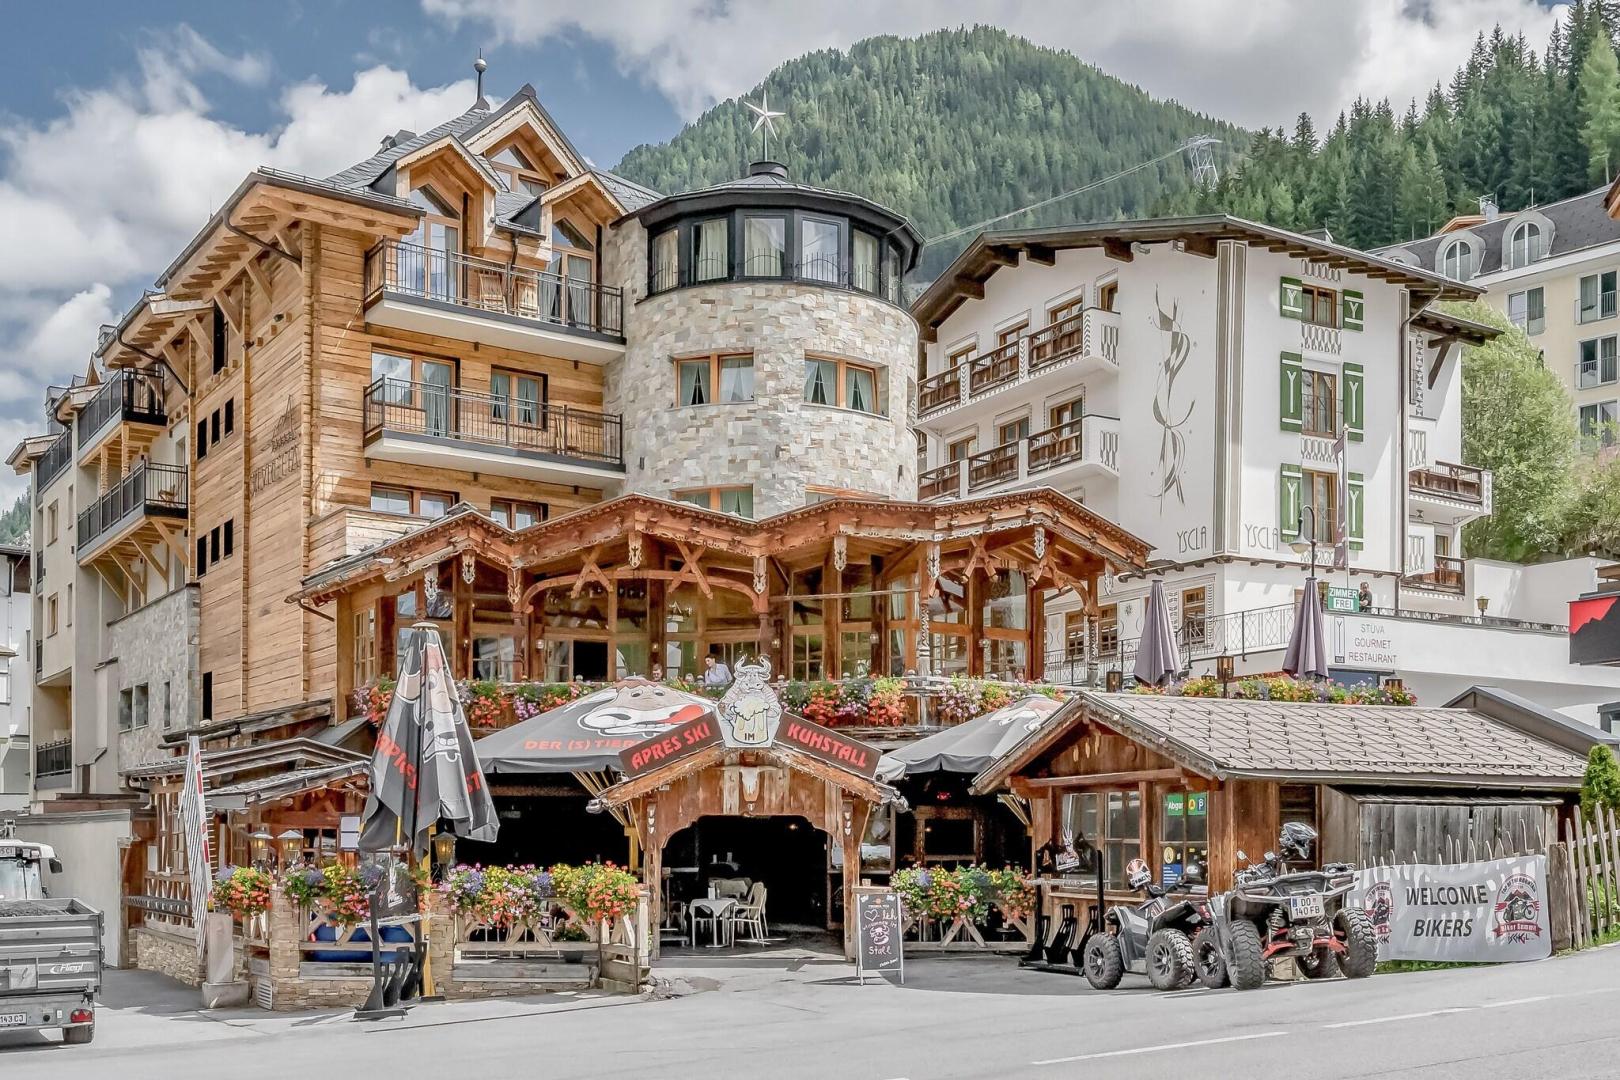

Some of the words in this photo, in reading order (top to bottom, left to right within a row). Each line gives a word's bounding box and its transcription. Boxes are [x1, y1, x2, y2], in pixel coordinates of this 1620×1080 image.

[1177, 526, 1207, 553] YSCLA
[1245, 524, 1279, 551] YSCLA
[1328, 588, 1358, 599] ZIMMER
[1335, 599, 1352, 608] FREI
[1354, 637, 1391, 649] GOURMET
[1348, 651, 1397, 664] RESTAURANT
[744, 732, 755, 741] IM
[524, 740, 561, 750] DER
[631, 739, 682, 770] APRES
[685, 722, 712, 746] SKI
[787, 722, 867, 769] KUHSTALL
[1406, 885, 1488, 906] WELCOME
[1413, 918, 1473, 937] BIKERS
[868, 945, 892, 955] Stall
